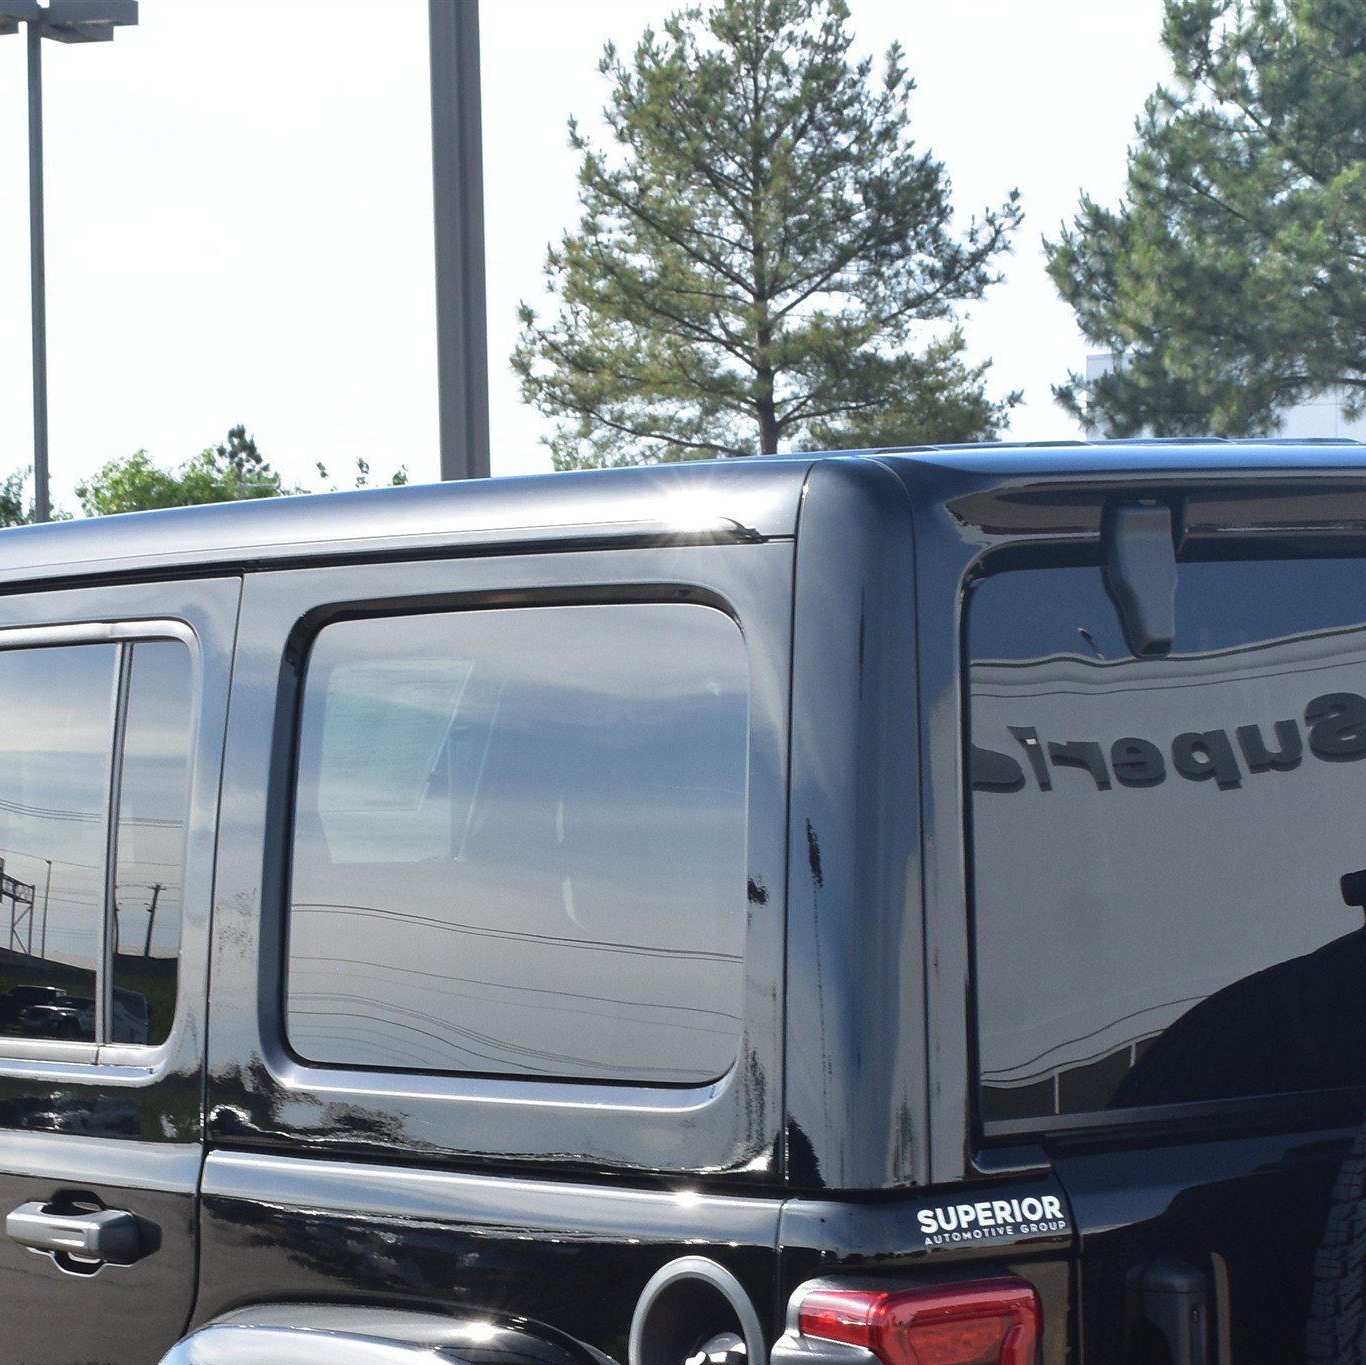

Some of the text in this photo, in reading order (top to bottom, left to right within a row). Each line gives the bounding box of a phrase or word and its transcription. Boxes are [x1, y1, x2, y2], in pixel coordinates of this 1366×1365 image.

[916, 1195, 1065, 1234] SUPERIOR
[924, 1220, 1067, 1246] AUTOMOTIVE GROUP
